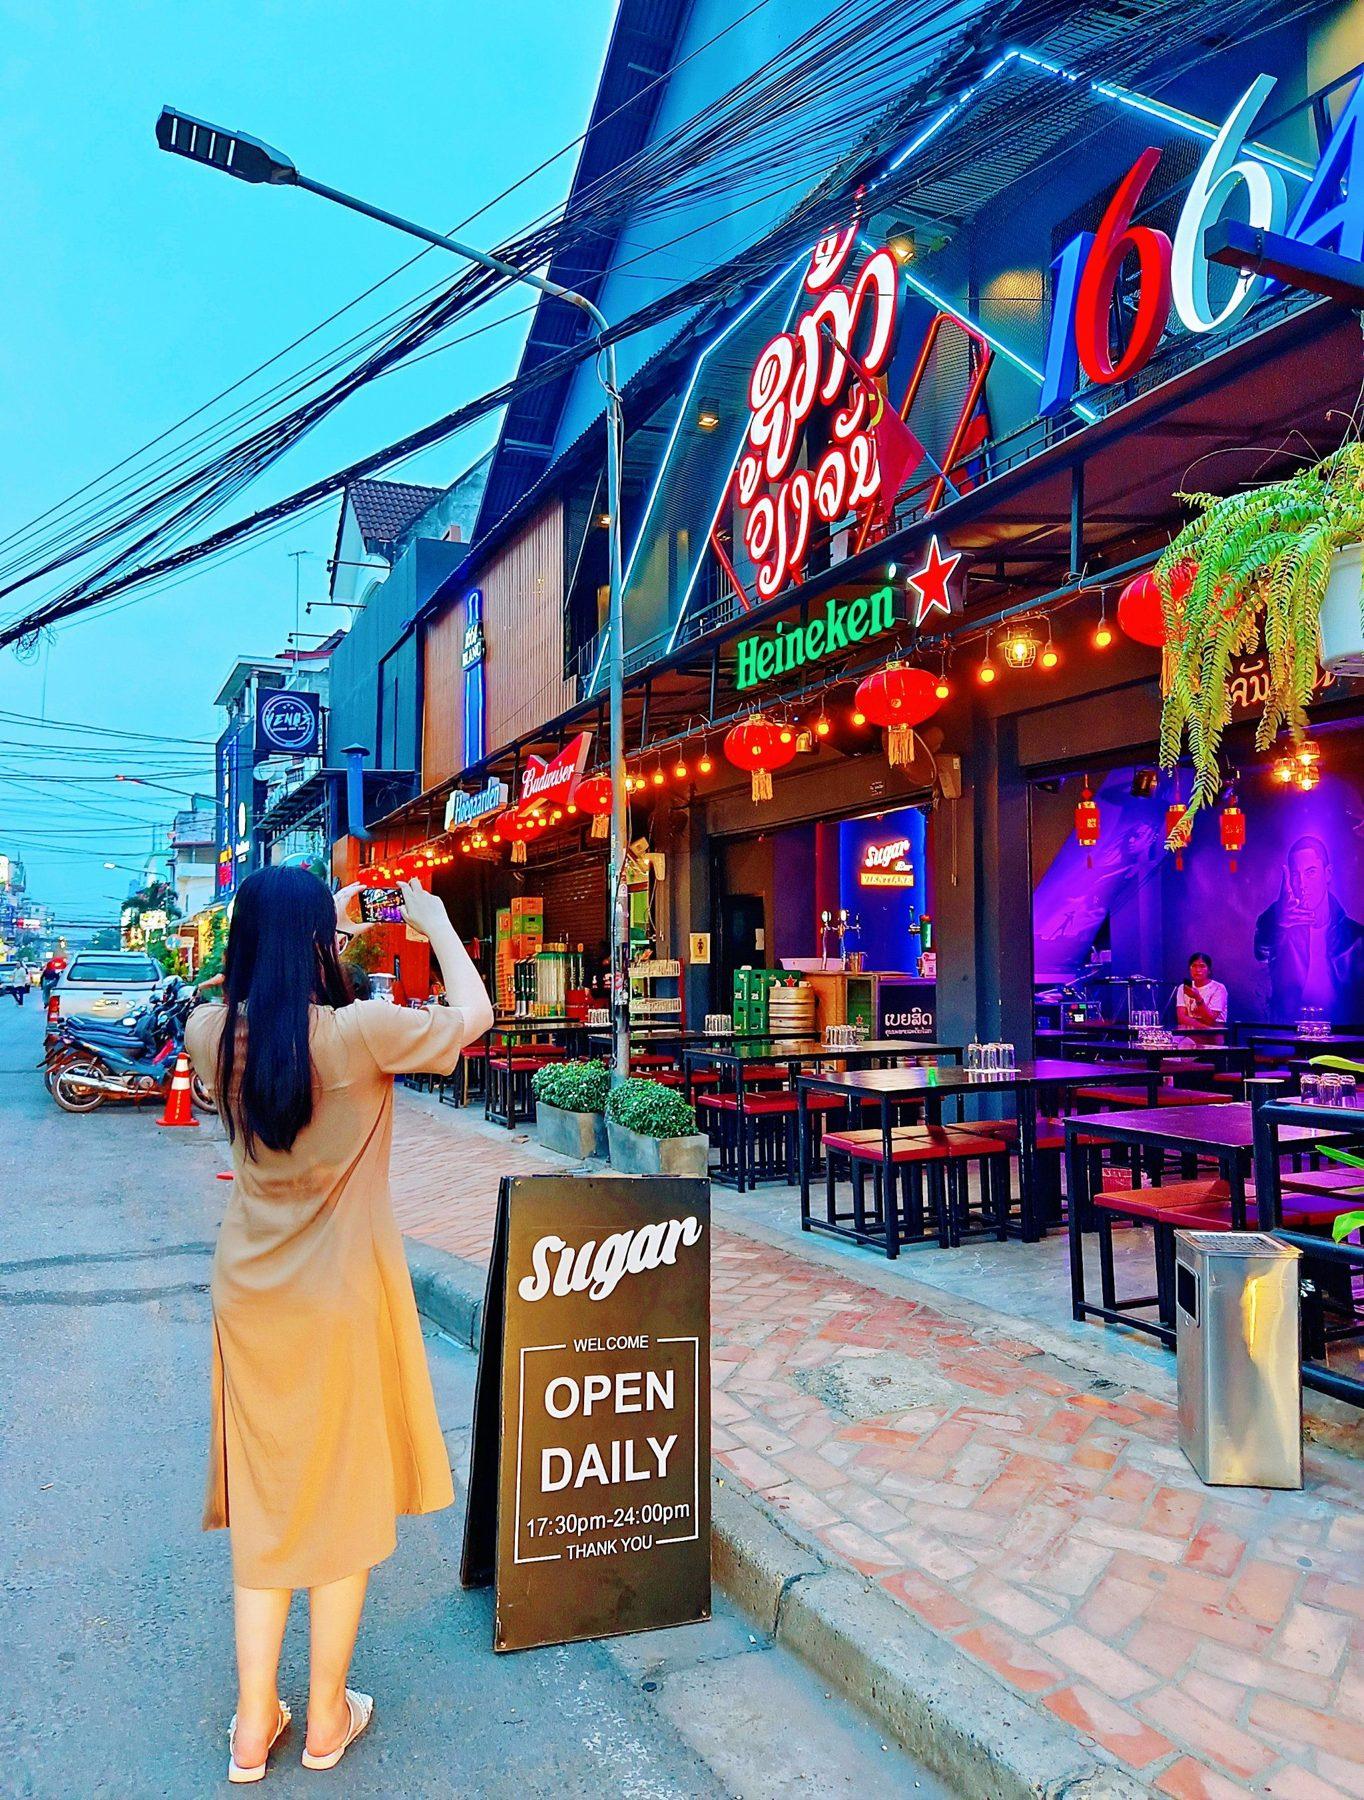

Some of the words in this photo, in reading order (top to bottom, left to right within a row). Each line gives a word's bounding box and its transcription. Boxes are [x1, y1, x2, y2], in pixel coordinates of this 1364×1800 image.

[1039, 74, 1364, 418] 1664
[737, 588, 894, 690] Heineken
[522, 762, 575, 799] Budweiser
[454, 787, 500, 825] Hoegaarden
[866, 840, 911, 868] Sugar
[518, 1216, 701, 1302] Sugar
[573, 1336, 649, 1352] WELCOME
[545, 1370, 675, 1418] OPEN
[541, 1435, 678, 1493] DAILY
[526, 1502, 690, 1538] 17:30pm-24:00pm
[566, 1541, 618, 1560] THANK
[620, 1535, 654, 1553] YOU
